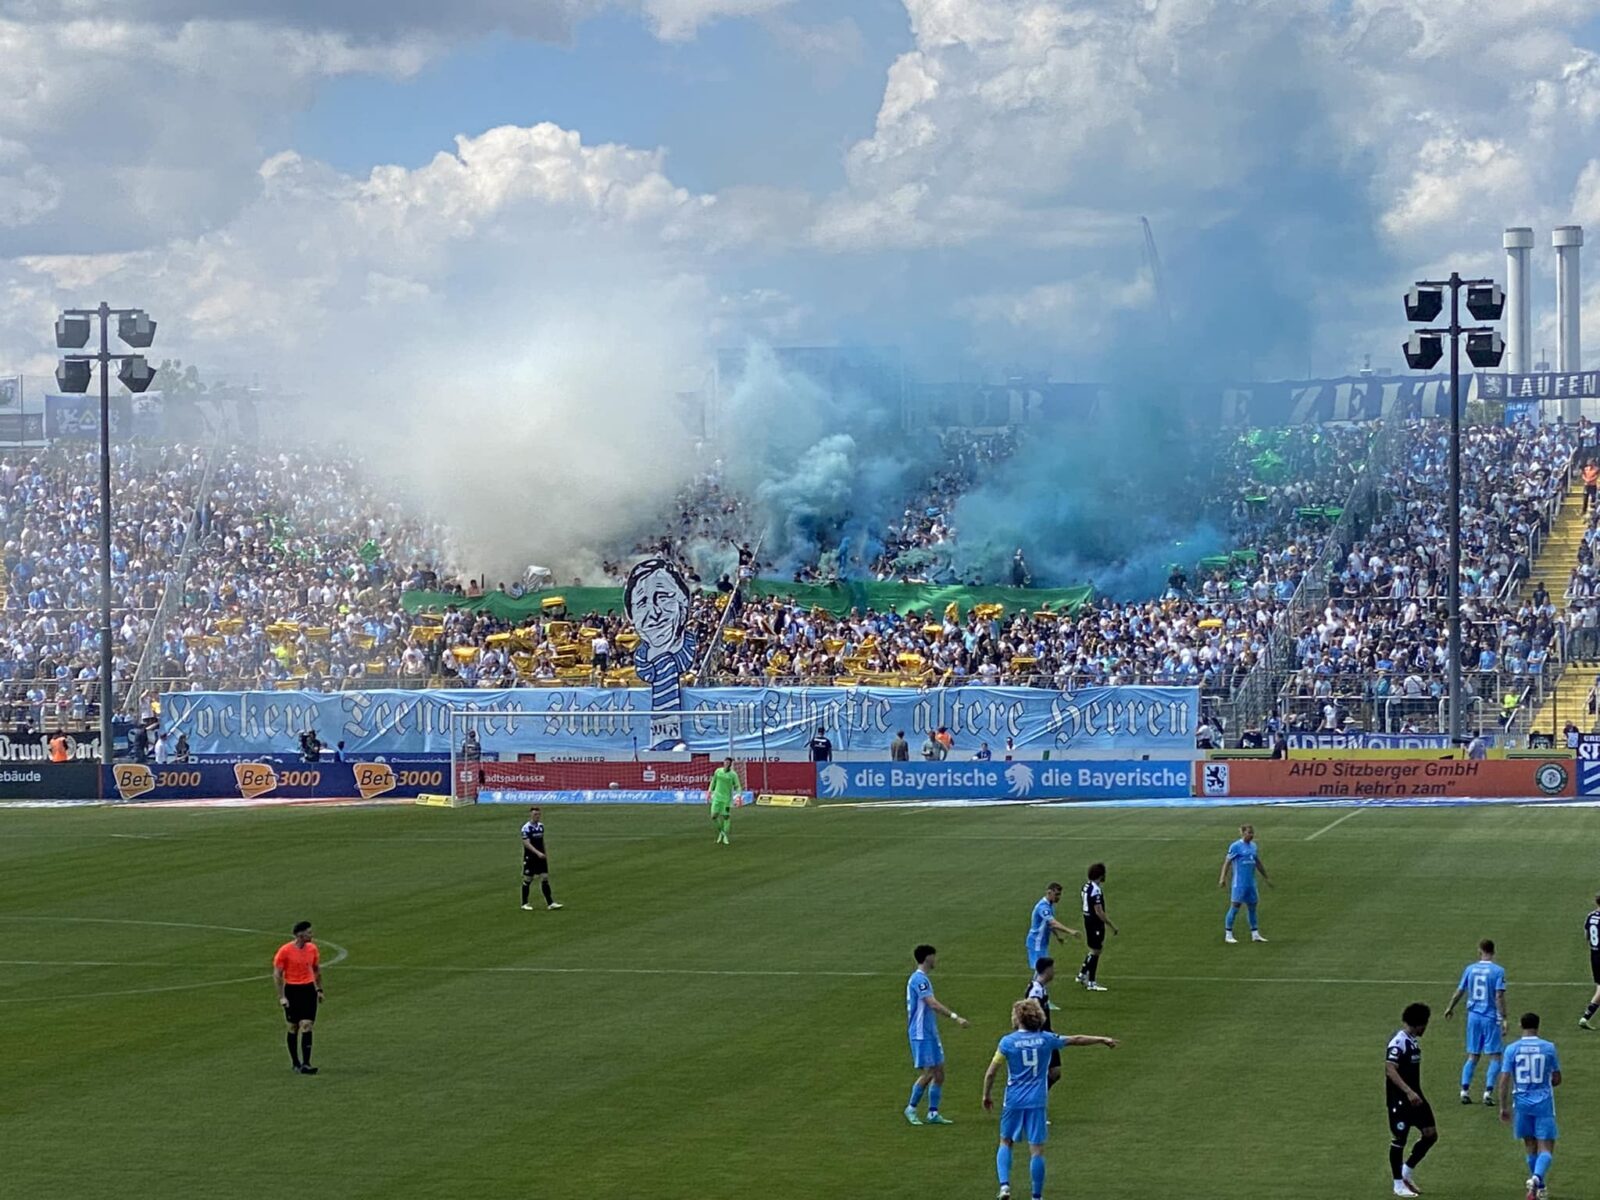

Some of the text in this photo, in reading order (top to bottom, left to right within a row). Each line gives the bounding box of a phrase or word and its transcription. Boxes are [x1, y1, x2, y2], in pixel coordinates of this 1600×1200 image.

[1506, 375, 1597, 397] LAUFEN
[912, 686, 1025, 737] ältere
[1047, 691, 1190, 749] Herren
[121, 770, 201, 787] Bet 3000
[242, 769, 321, 787] Bet 3000
[361, 769, 442, 787] Bet 3000
[854, 768, 998, 790] die Bayerische
[1041, 768, 1187, 790] die Bayerische
[1289, 762, 1479, 779] AHD Sitzberger GmbH
[1473, 975, 1487, 1000] 6
[1022, 1048, 1038, 1077] 4
[1515, 1054, 1546, 1084] 20
